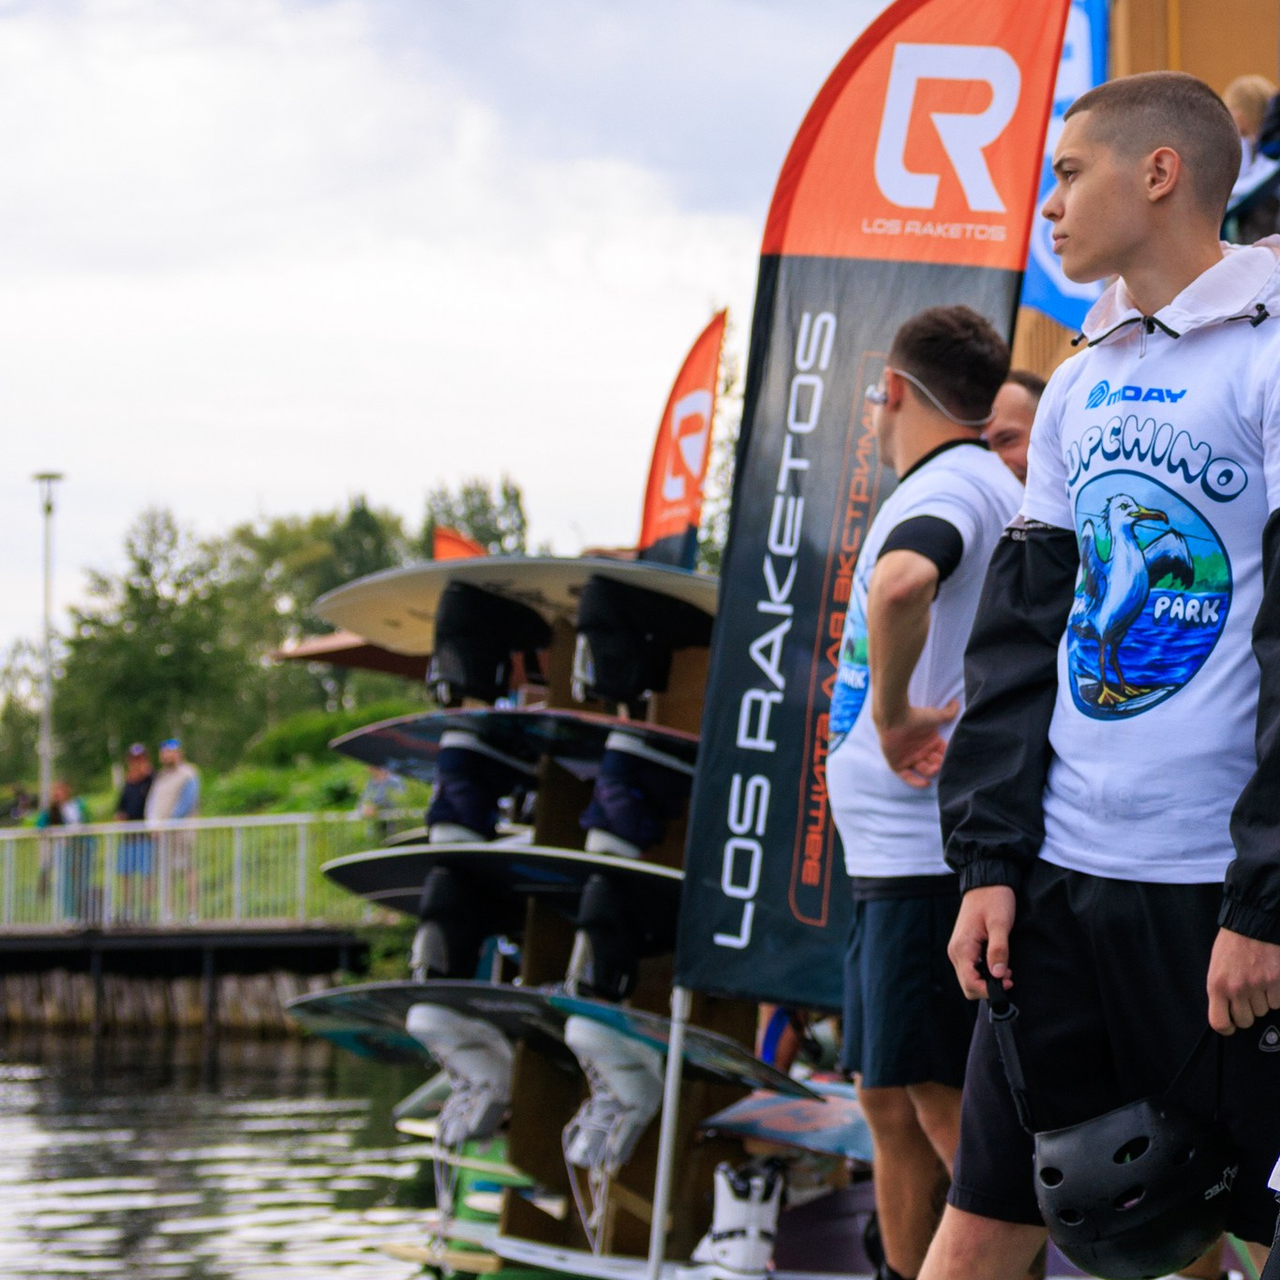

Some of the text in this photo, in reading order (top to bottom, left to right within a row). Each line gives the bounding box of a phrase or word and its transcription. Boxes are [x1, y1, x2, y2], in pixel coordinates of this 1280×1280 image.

[861, 218, 1007, 241] LOS RAKETOS
[1065, 414, 1248, 503] UPCHINO
[713, 310, 836, 950] LOS RAKETOS
[1154, 595, 1219, 624] PARK
